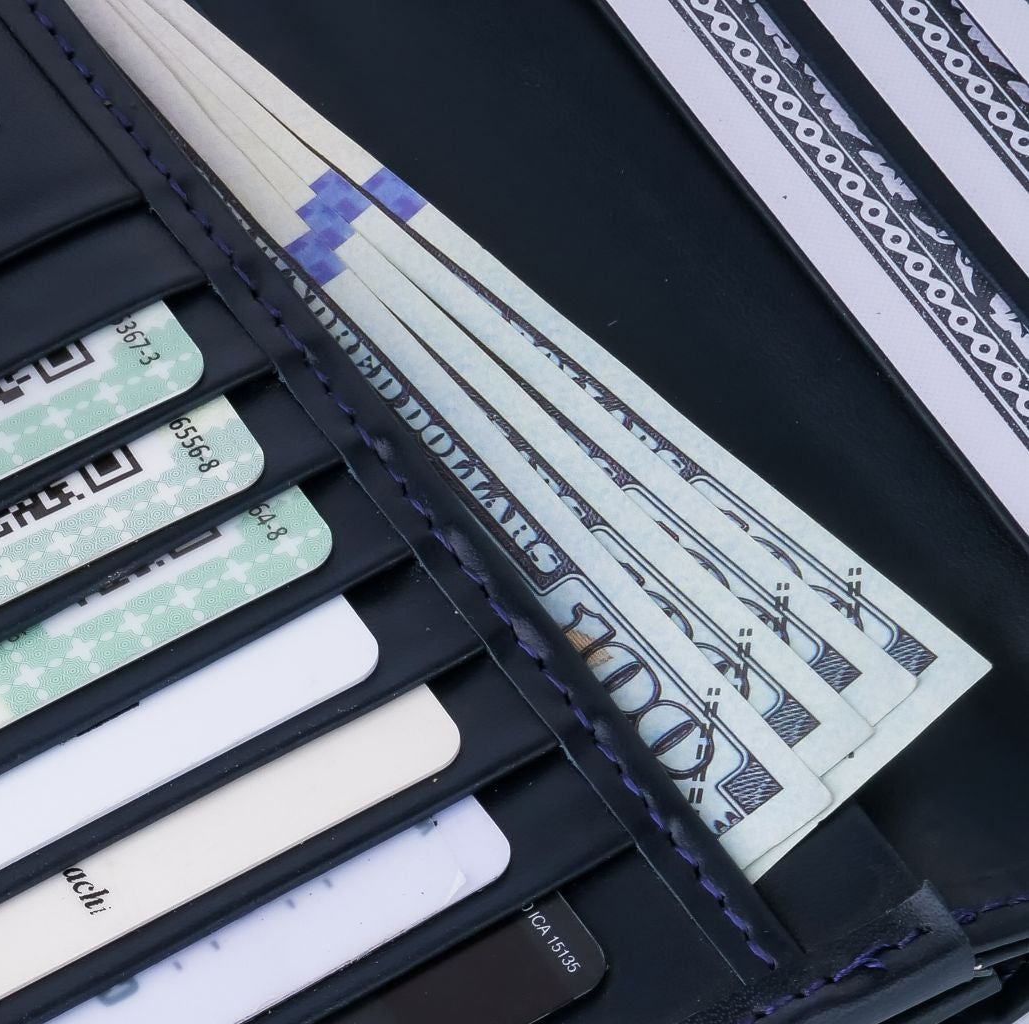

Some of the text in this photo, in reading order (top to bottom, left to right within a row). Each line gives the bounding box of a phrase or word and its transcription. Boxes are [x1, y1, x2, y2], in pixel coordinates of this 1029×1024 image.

[169, 417, 220, 473] 6556-8
[528, 911, 582, 973] ICA 15135
